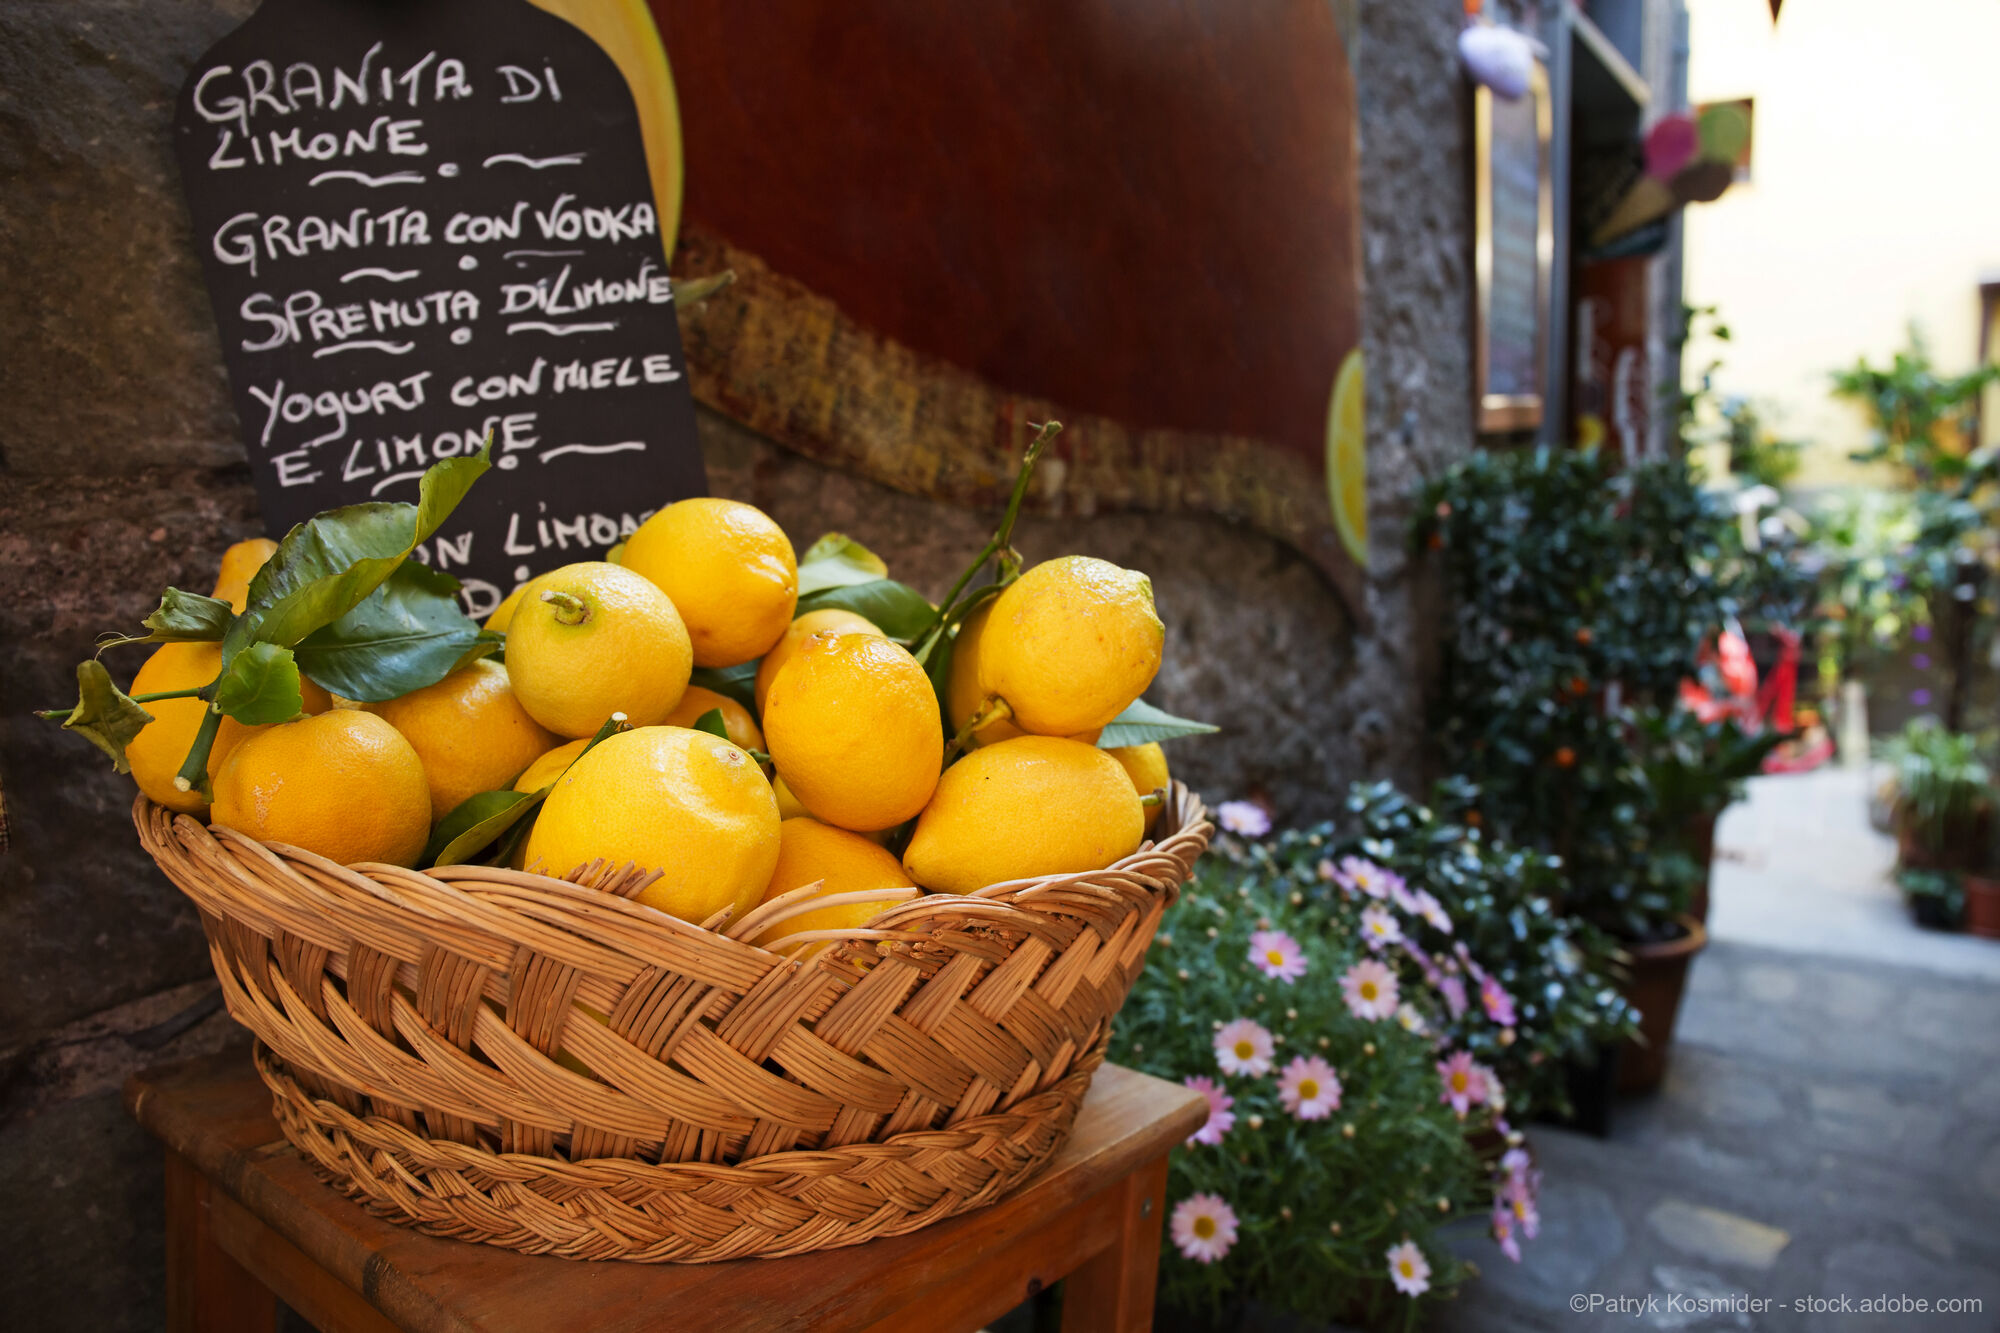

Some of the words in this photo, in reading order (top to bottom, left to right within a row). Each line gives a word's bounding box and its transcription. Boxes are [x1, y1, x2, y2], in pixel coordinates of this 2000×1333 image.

[193, 41, 473, 138] GRANITA
[208, 116, 429, 170] LIMONE
[213, 206, 432, 278] GRANITA
[444, 202, 531, 244] CON
[535, 193, 655, 242] VODKA
[240, 290, 480, 352] SPREMUTA
[450, 356, 548, 407] CON
[553, 354, 681, 393] MIELE
[270, 449, 324, 488] E
